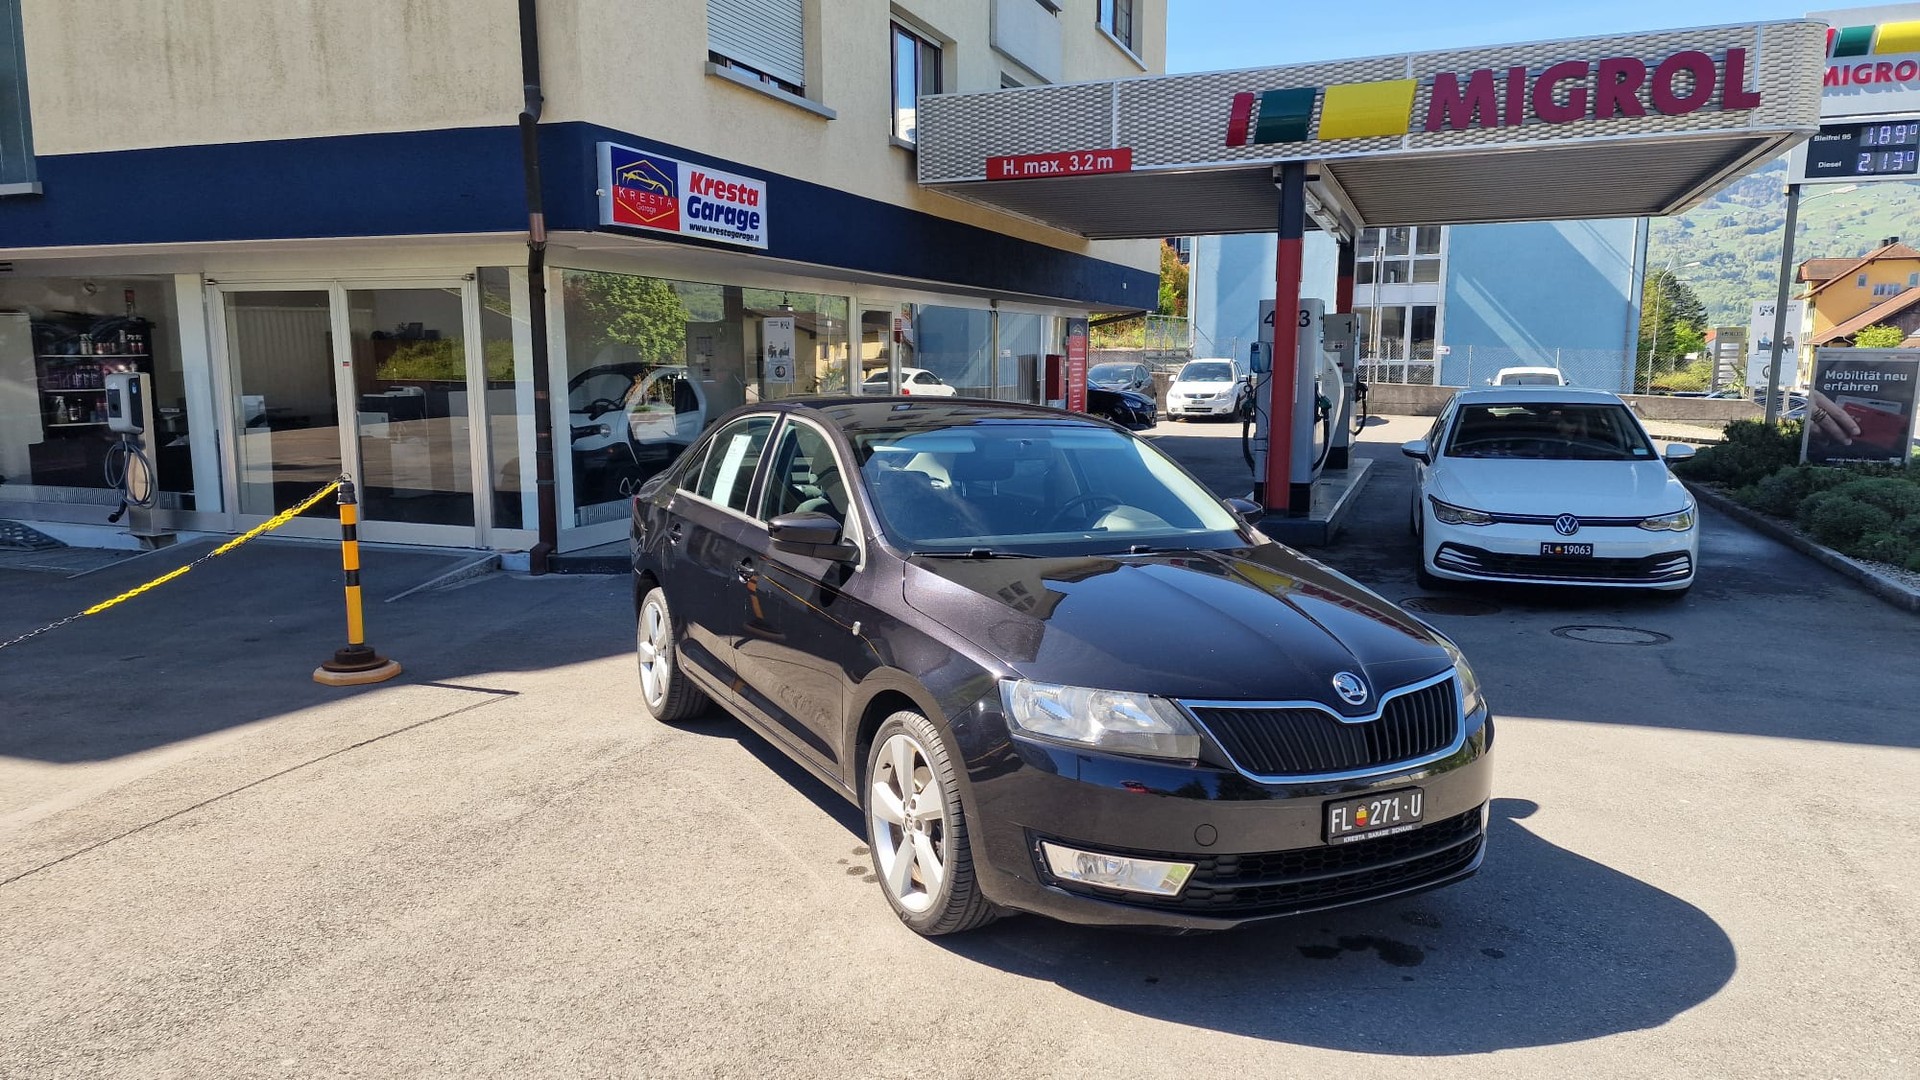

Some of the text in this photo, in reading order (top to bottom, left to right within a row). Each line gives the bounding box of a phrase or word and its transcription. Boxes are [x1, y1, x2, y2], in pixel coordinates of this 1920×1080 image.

[1824, 60, 1920, 87] MIGRO
[1425, 47, 1761, 132] MIGROL
[1003, 154, 1113, 176] H. max. 3.2 m
[618, 186, 673, 208] KRESTA
[689, 171, 759, 207] Kresta
[635, 202, 657, 215] Garage
[687, 196, 760, 231] Garage
[1264, 310, 1276, 328] 4
[1298, 309, 1311, 328] 3
[1823, 381, 1879, 392] erfahren
[1825, 370, 1908, 381] Mobilität neu
[1543, 544, 1591, 555] FL 19063
[1331, 807, 1352, 833] FL
